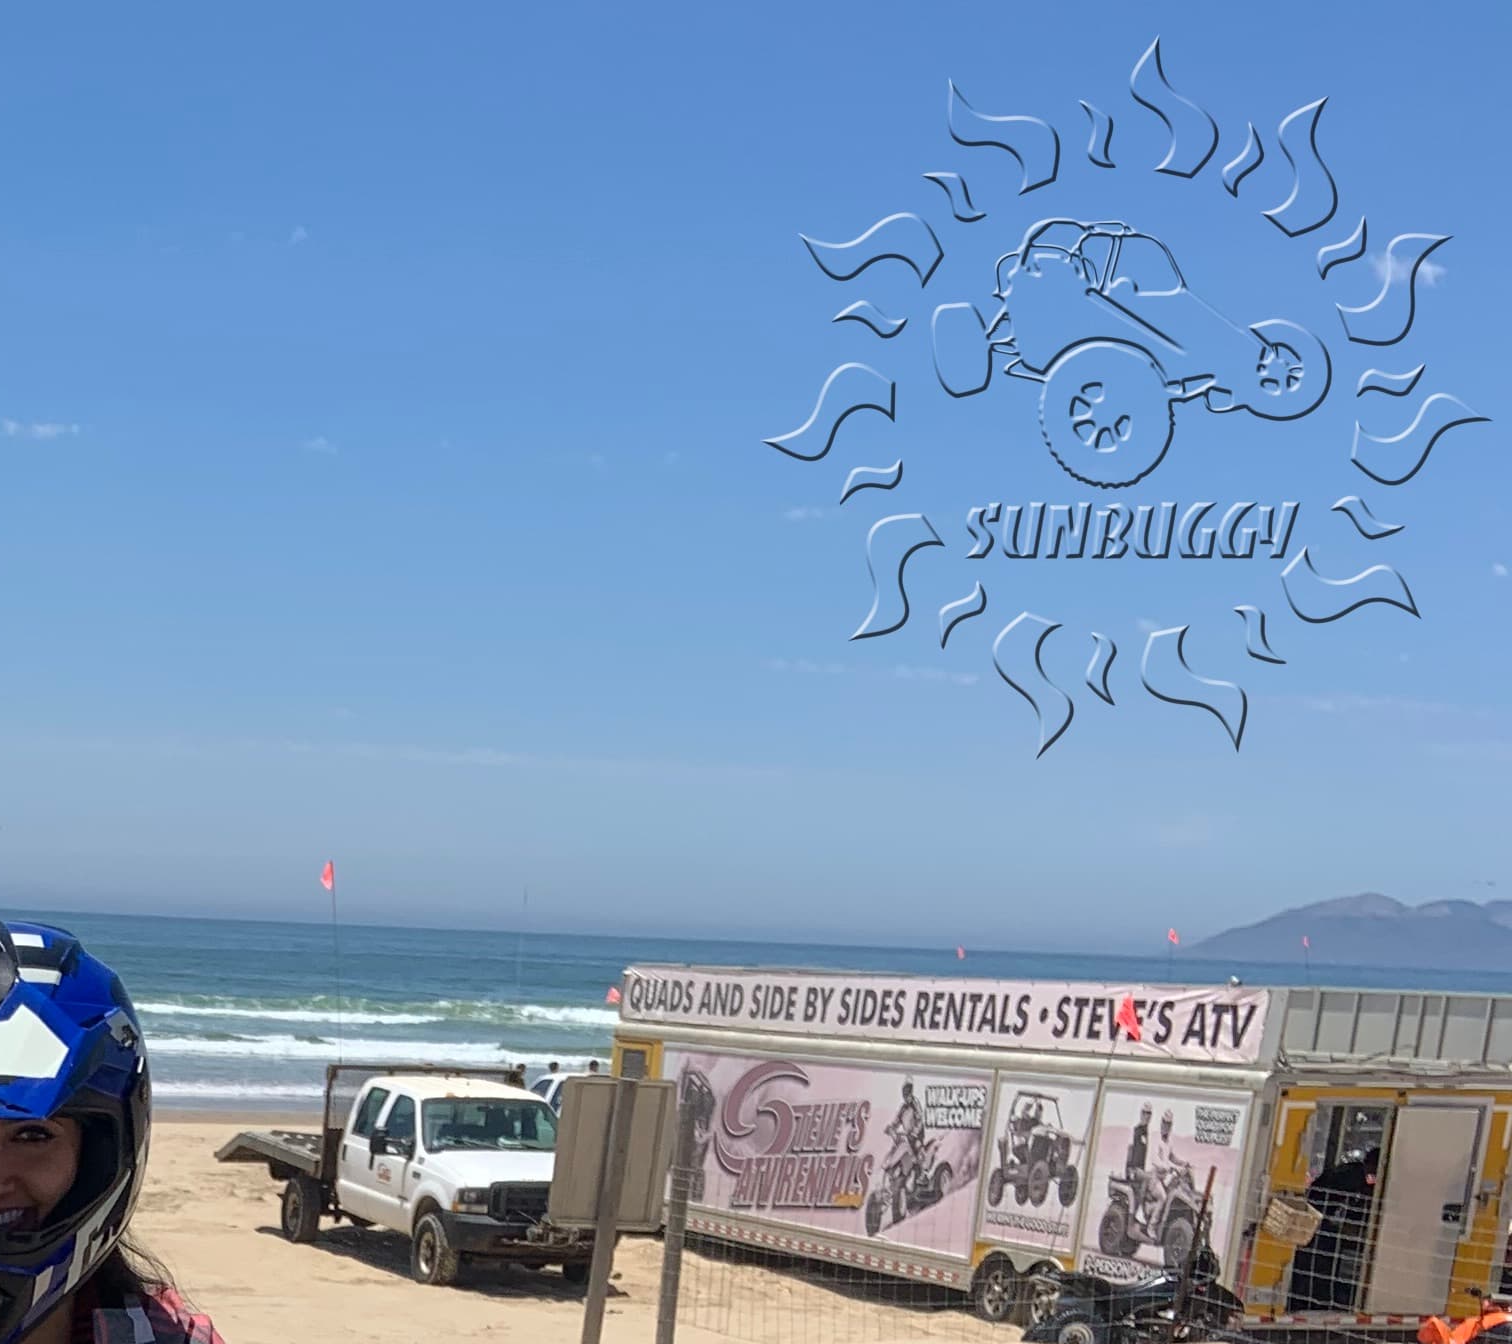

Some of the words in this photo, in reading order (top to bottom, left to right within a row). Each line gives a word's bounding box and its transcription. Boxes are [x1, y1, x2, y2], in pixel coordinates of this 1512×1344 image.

[630, 978, 695, 1014] QUADS
[698, 981, 744, 1017] AND
[749, 984, 798, 1021] SIDE
[803, 986, 835, 1024] BY
[837, 987, 906, 1029] SIDES
[912, 991, 1032, 1036] RENTALS
[1181, 1003, 1257, 1049] ATV
[714, 1060, 872, 1174] STEVE'S
[732, 1154, 779, 1209] ATV
[775, 1153, 874, 1209] RENTALS
